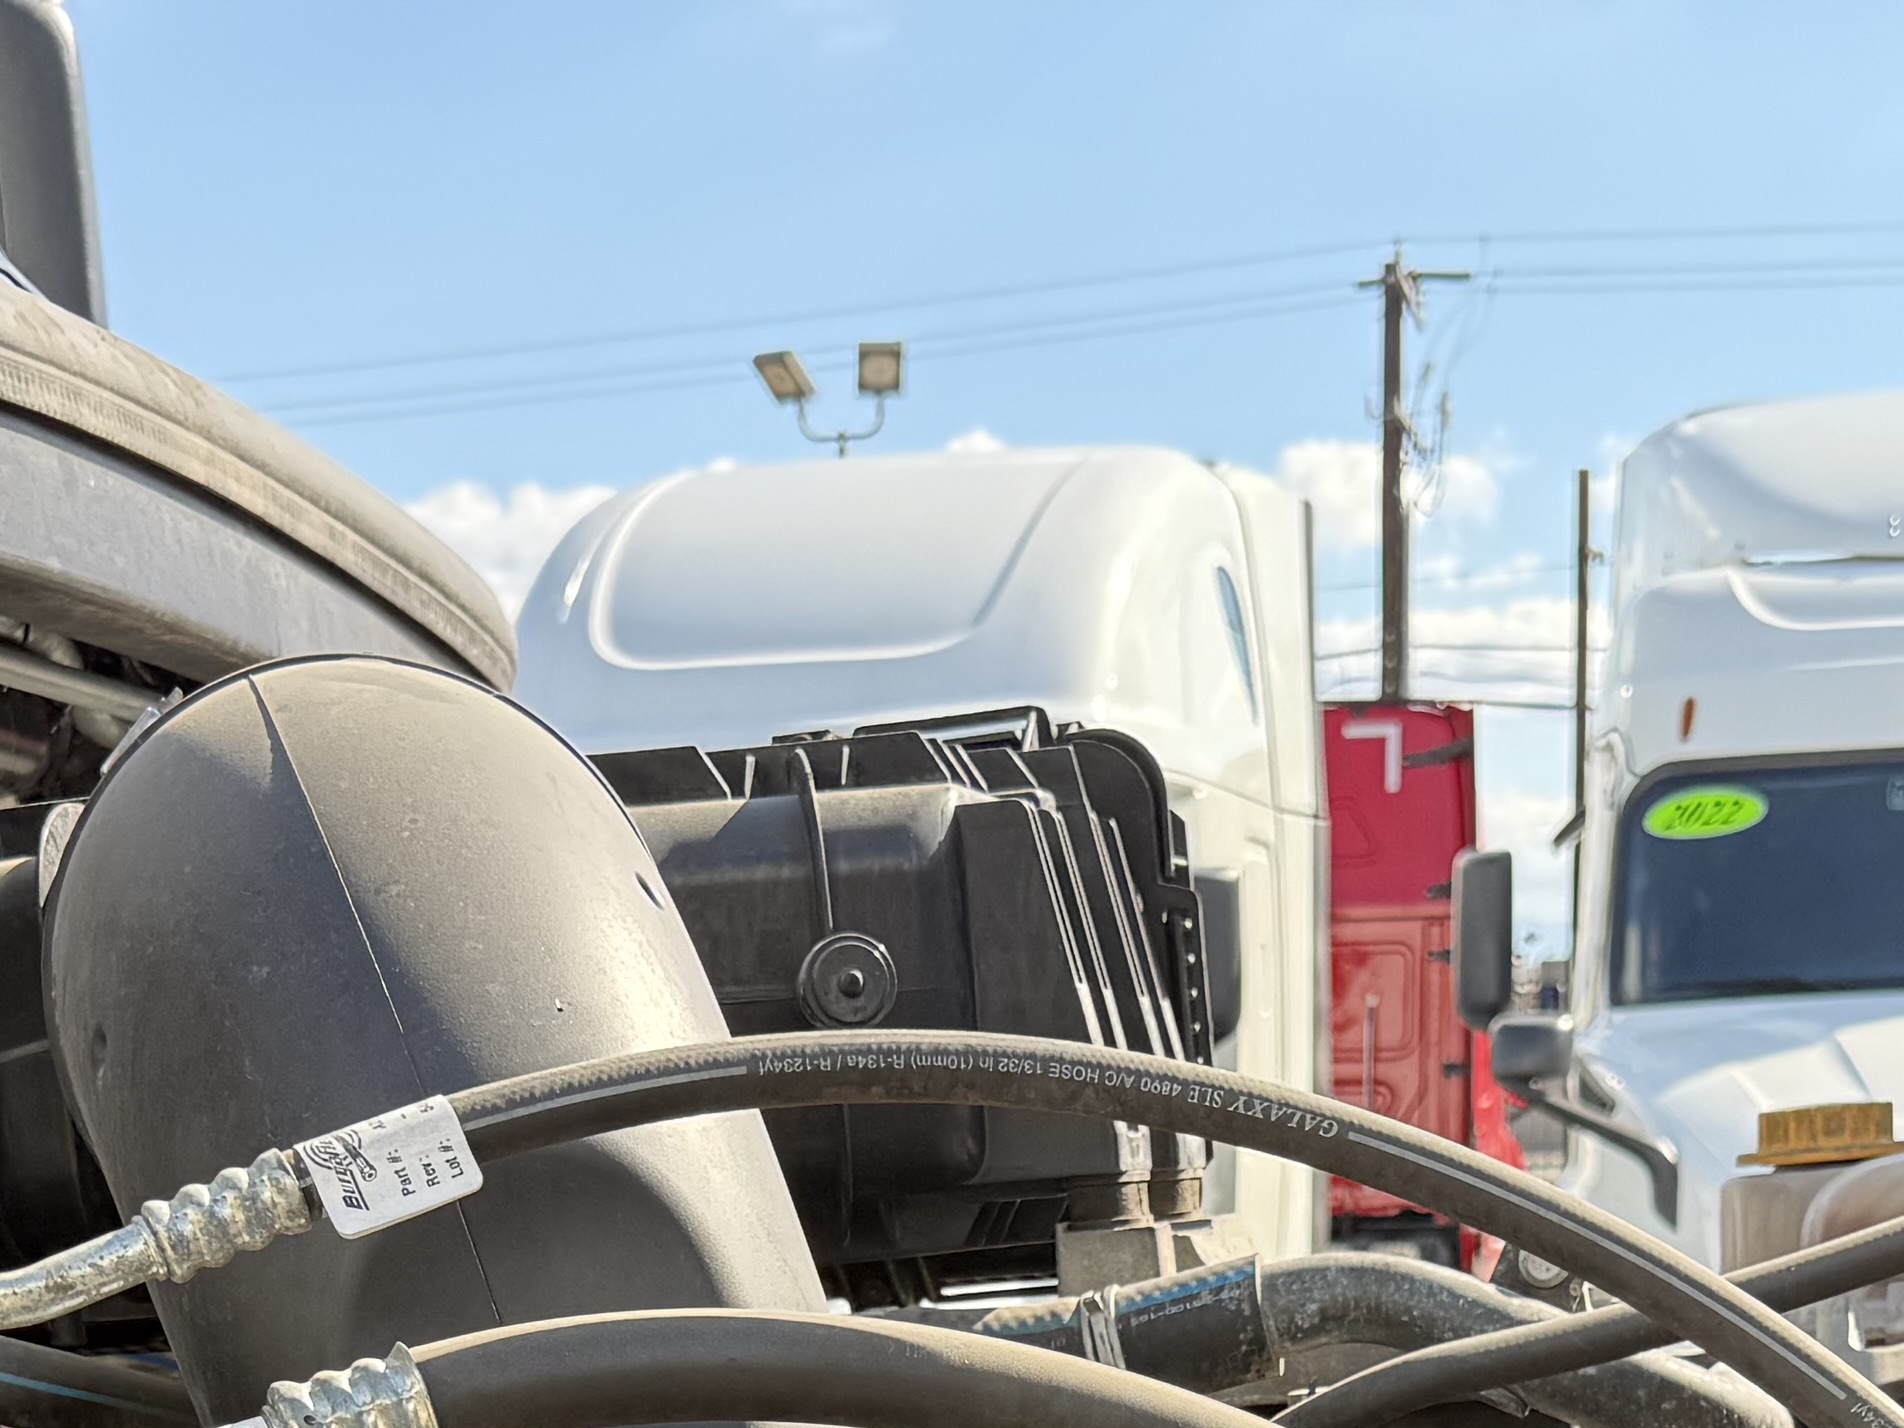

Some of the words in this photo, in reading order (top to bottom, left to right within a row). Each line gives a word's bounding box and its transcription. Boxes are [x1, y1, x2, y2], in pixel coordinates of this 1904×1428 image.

[1664, 799, 1745, 832] 2022
[846, 1053, 904, 1070] R-134a
[911, 1051, 974, 1072] (10mm)
[979, 1055, 994, 1071] in
[998, 1057, 1044, 1075] 13/32
[1048, 1062, 1100, 1084] HOSE
[1104, 1071, 1135, 1089] A/C
[1140, 1075, 1182, 1097] 4890
[1187, 1084, 1224, 1108] SLE
[1227, 1094, 1340, 1138] GALAXY
[445, 1153, 464, 1179] Lot
[394, 1166, 416, 1197] Part
